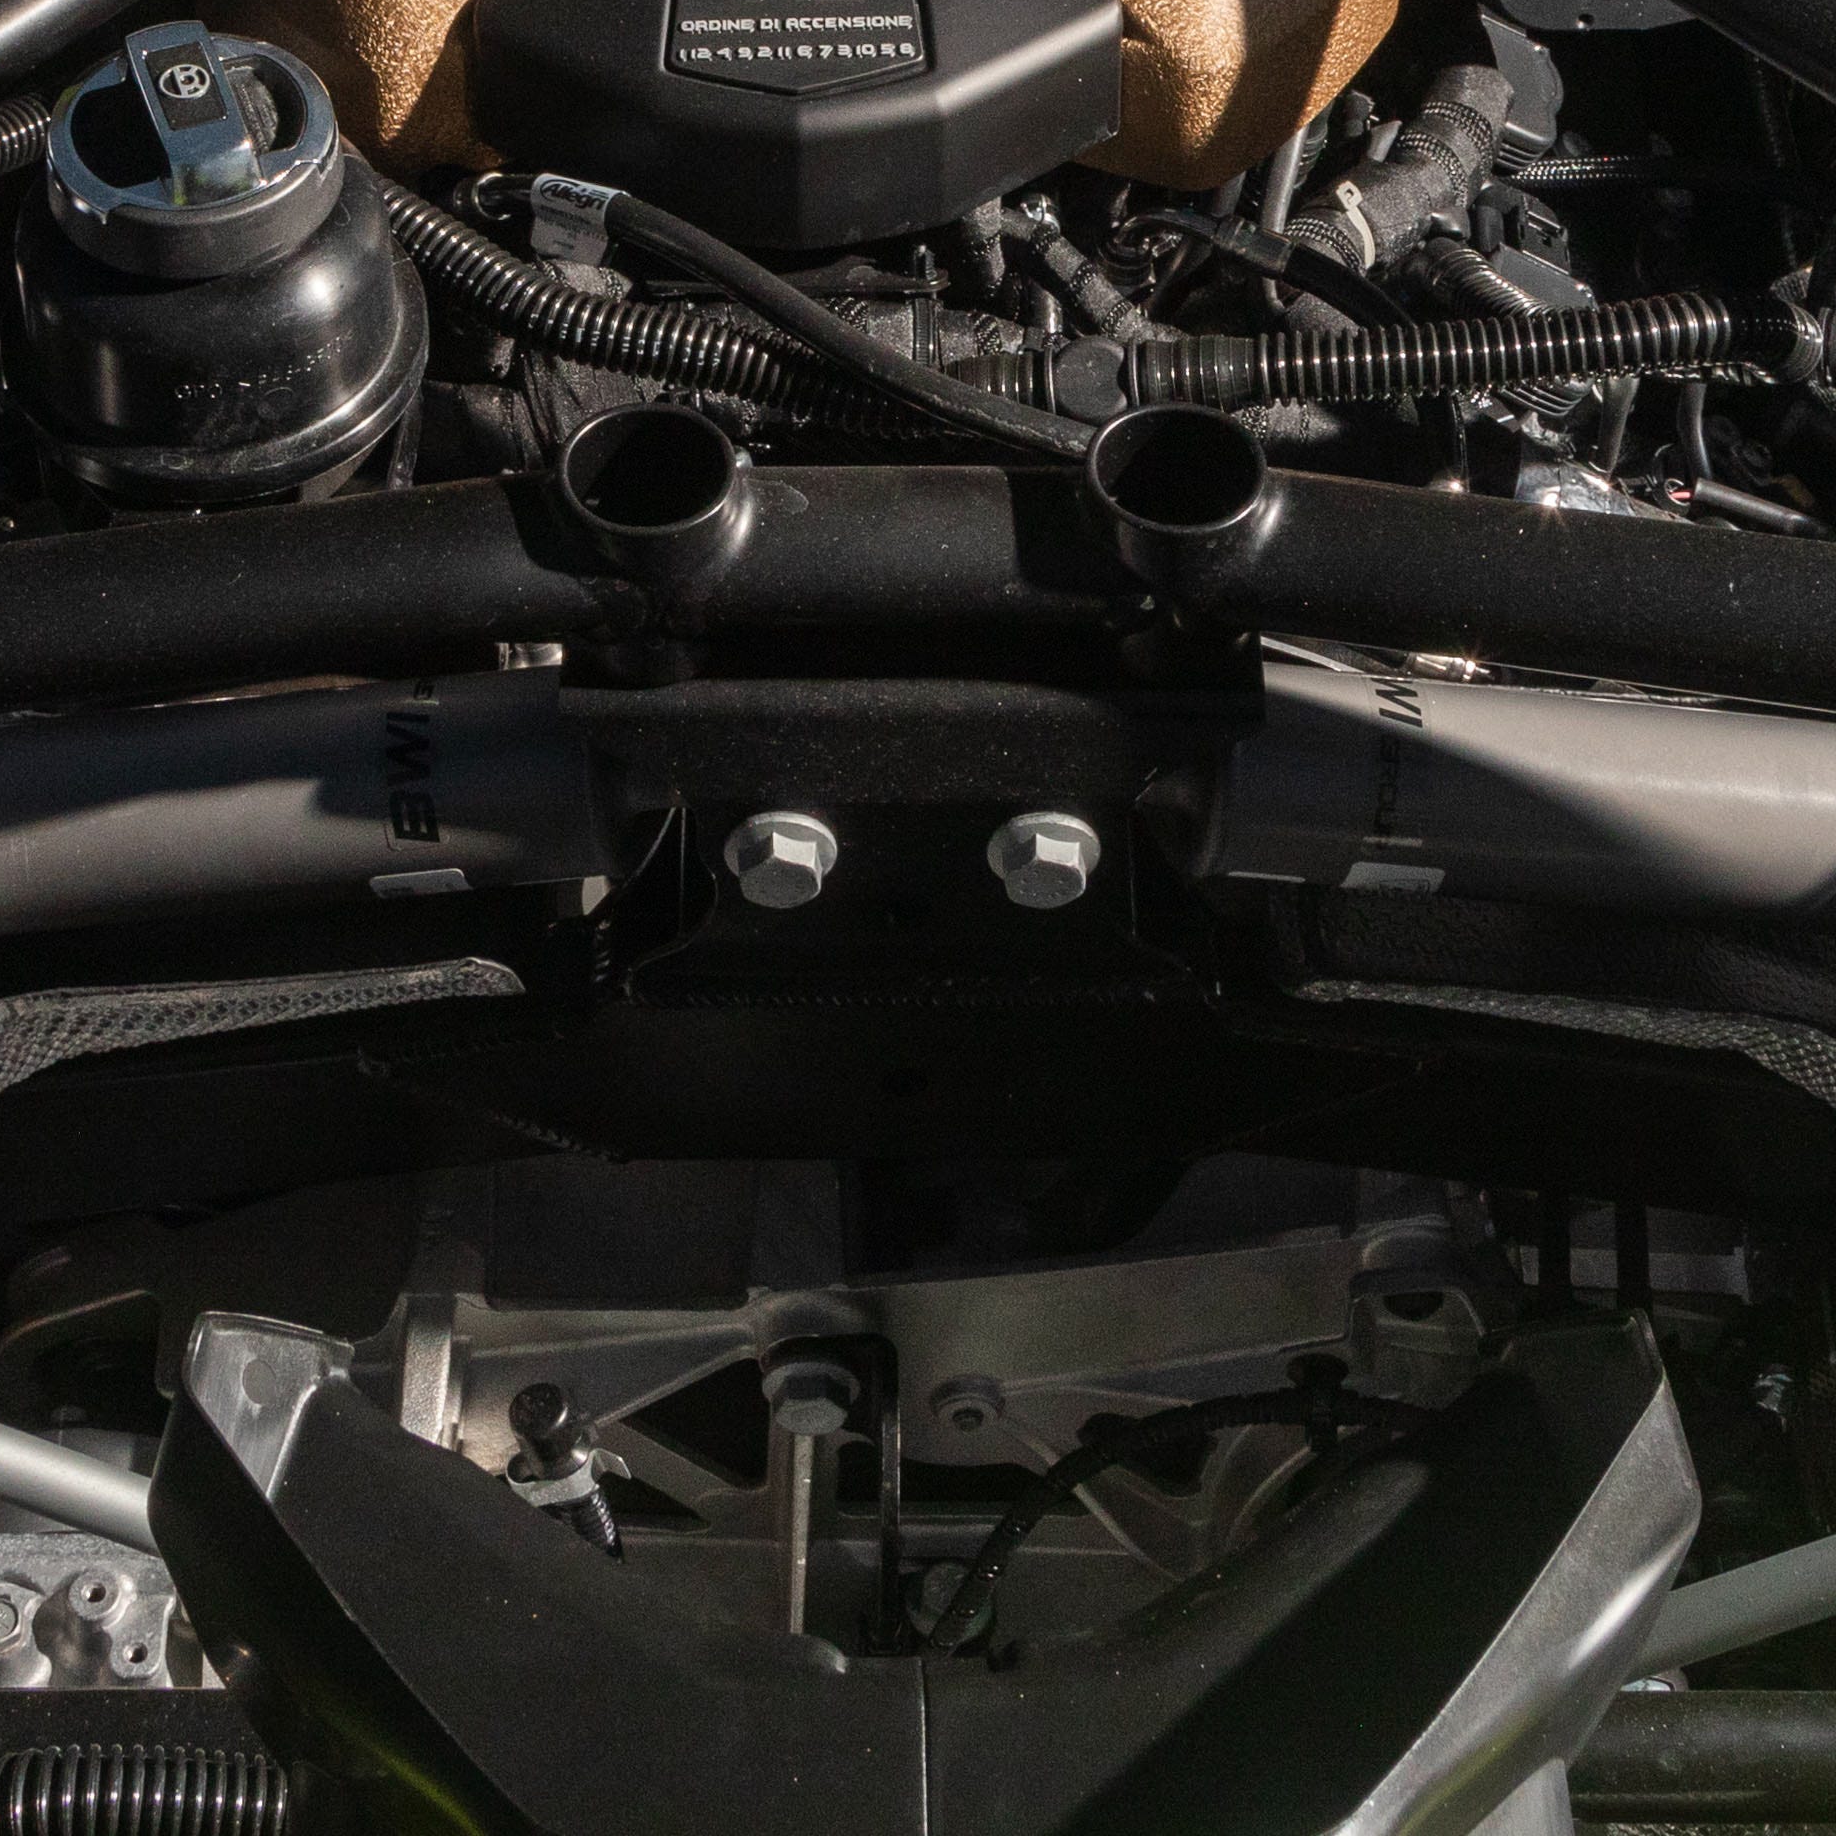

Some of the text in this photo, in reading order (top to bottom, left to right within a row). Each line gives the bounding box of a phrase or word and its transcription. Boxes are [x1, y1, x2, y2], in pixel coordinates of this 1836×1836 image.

[680, 15, 914, 34] ORDINE DI ACCENSIONE
[691, 47, 713, 61] 12
[716, 47, 733, 61] 4
[737, 46, 754, 60] 9
[757, 46, 773, 60] 2
[777, 46, 793, 60] 11
[797, 45, 813, 58] 6
[818, 45, 834, 58] 7
[837, 44, 853, 58] 3
[856, 44, 877, 57] 10
[880, 43, 896, 57] 5
[899, 43, 916, 57] 8
[1371, 677, 1424, 729] WI
